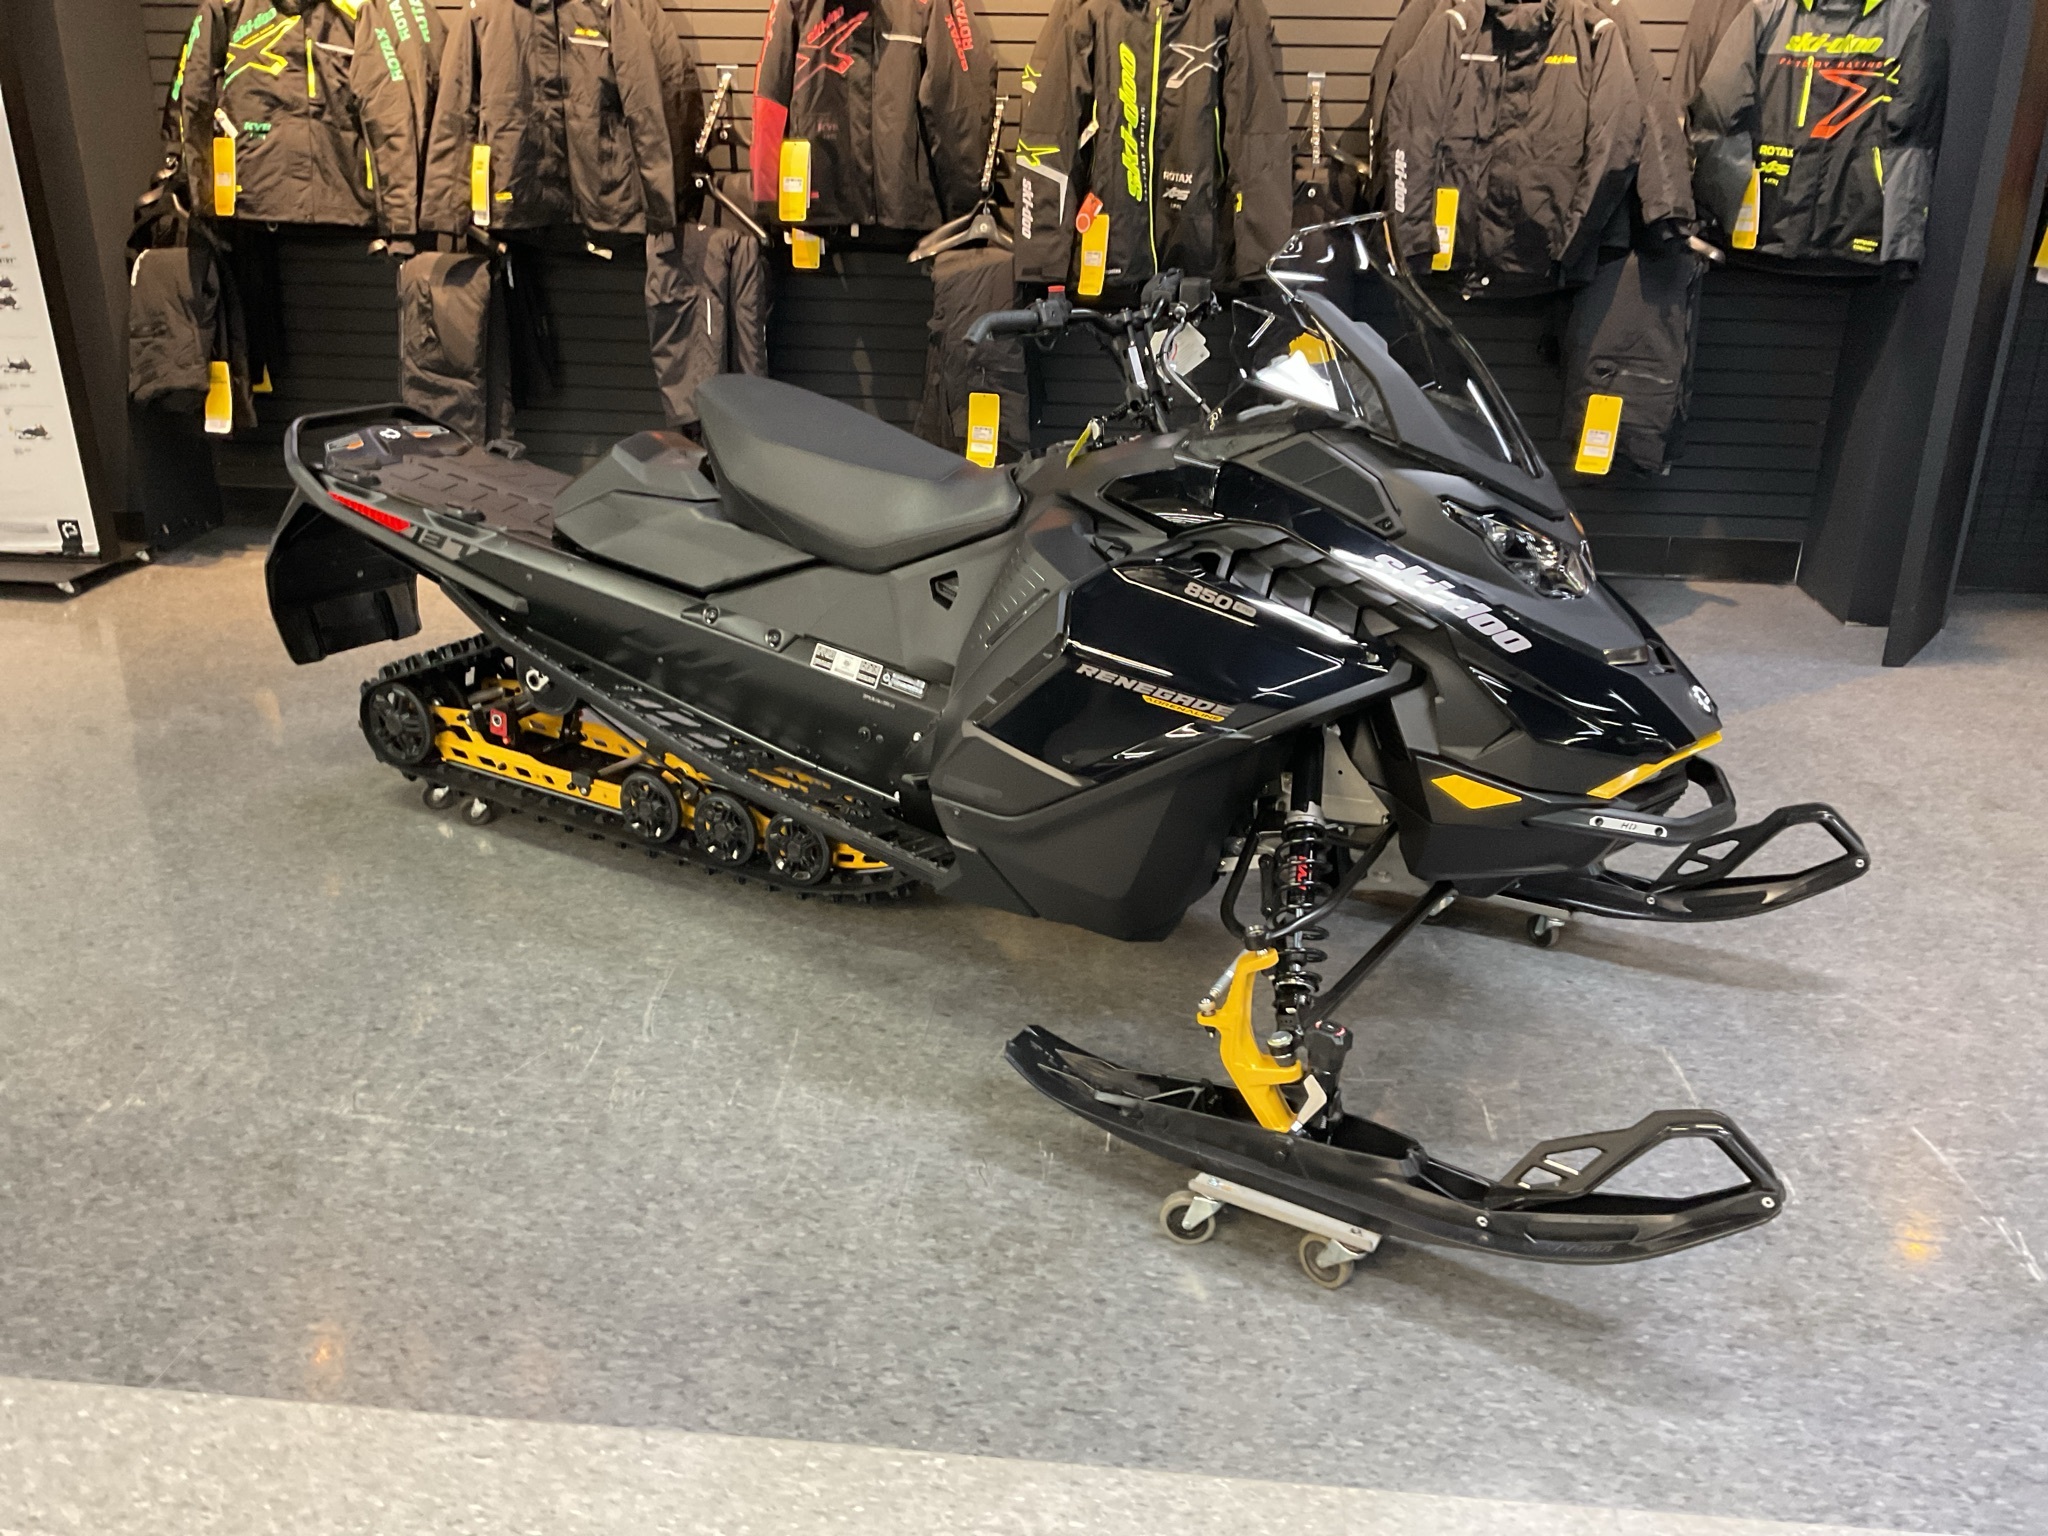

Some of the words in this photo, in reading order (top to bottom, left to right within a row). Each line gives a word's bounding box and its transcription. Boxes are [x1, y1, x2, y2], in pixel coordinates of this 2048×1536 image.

[374, 27, 405, 82] ROTAX
[1118, 42, 1143, 202] ski-doo
[1163, 170, 1193, 185] ROTAX
[1760, 145, 1794, 158] ROTAX
[1394, 148, 1408, 213] ski-doo
[1021, 177, 1034, 240] ski-doo
[1184, 581, 1234, 610] 850
[1076, 663, 1237, 717] RENEGADE
